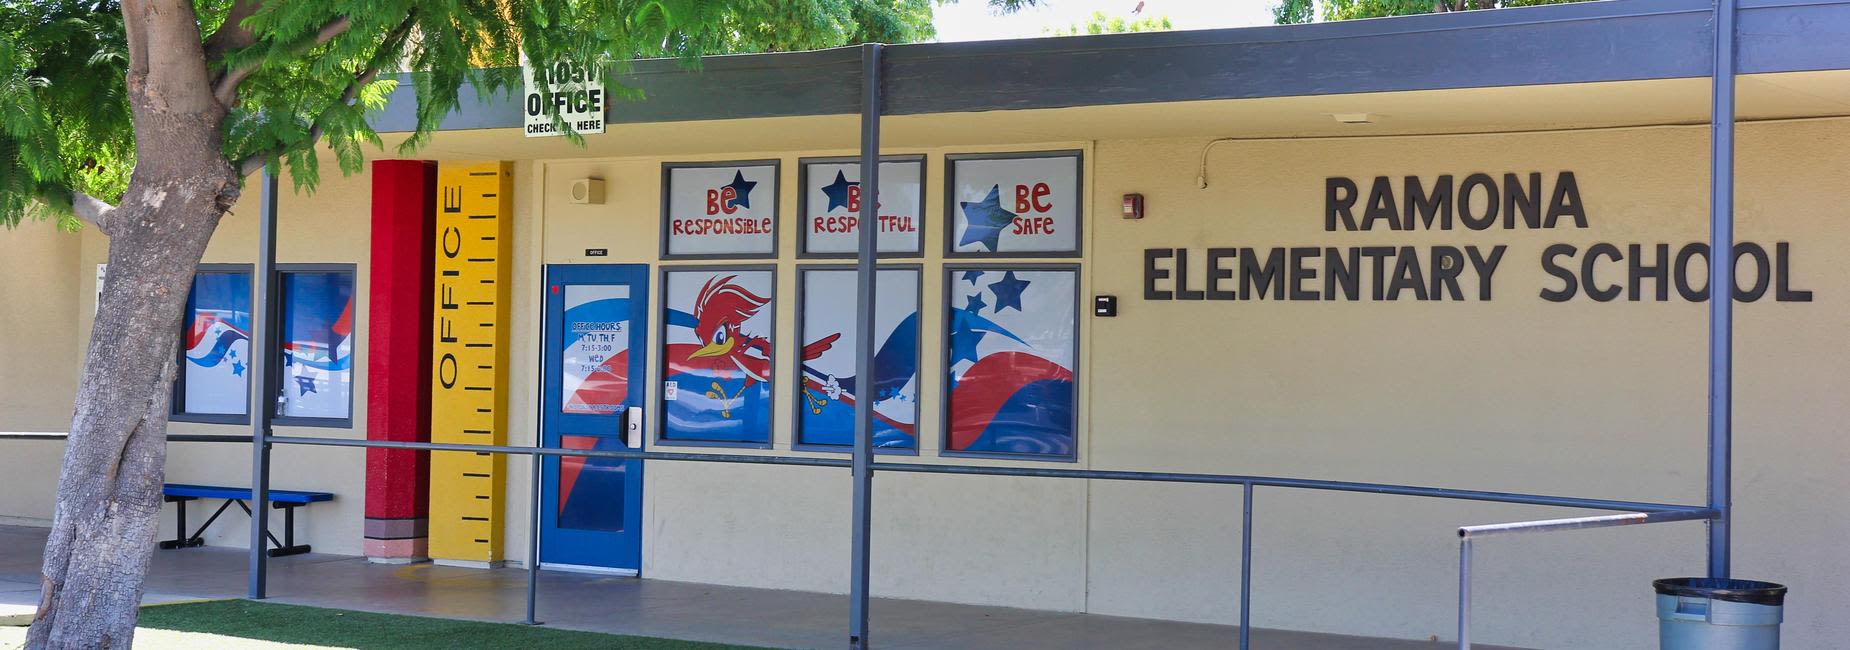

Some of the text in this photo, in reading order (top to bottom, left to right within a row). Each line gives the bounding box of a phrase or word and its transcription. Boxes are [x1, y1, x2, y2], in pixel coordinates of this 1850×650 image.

[527, 90, 601, 116] OFFICE
[527, 123, 556, 134] CHECK
[577, 120, 601, 131] HERE
[848, 186, 881, 212] B
[1325, 171, 1589, 232] RAMONA
[814, 216, 916, 233] ReSPTFUL
[1143, 241, 1813, 303] ELEMENTARY SCHOOL
[440, 185, 462, 389] OFFICE
